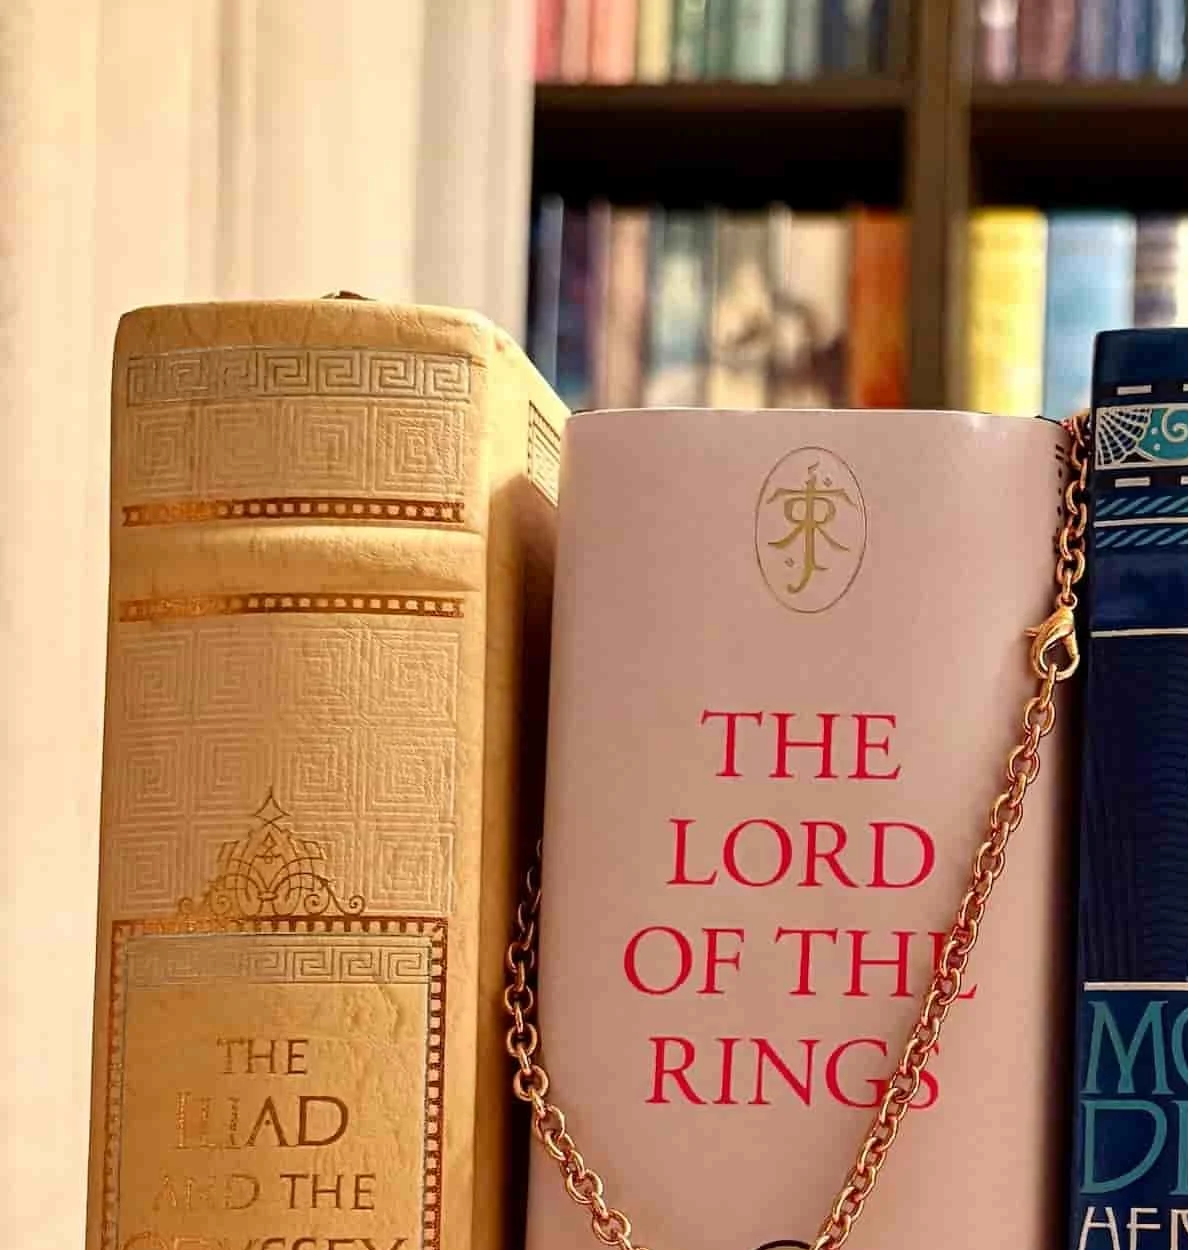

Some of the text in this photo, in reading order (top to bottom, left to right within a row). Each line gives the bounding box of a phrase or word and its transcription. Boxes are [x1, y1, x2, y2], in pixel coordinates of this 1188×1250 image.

[701, 709, 902, 781] THE
[666, 817, 936, 889] LORD
[623, 926, 746, 996] OF
[217, 1038, 309, 1075] THE
[172, 1090, 349, 1151] ILIAD
[280, 1173, 376, 1211] THE
